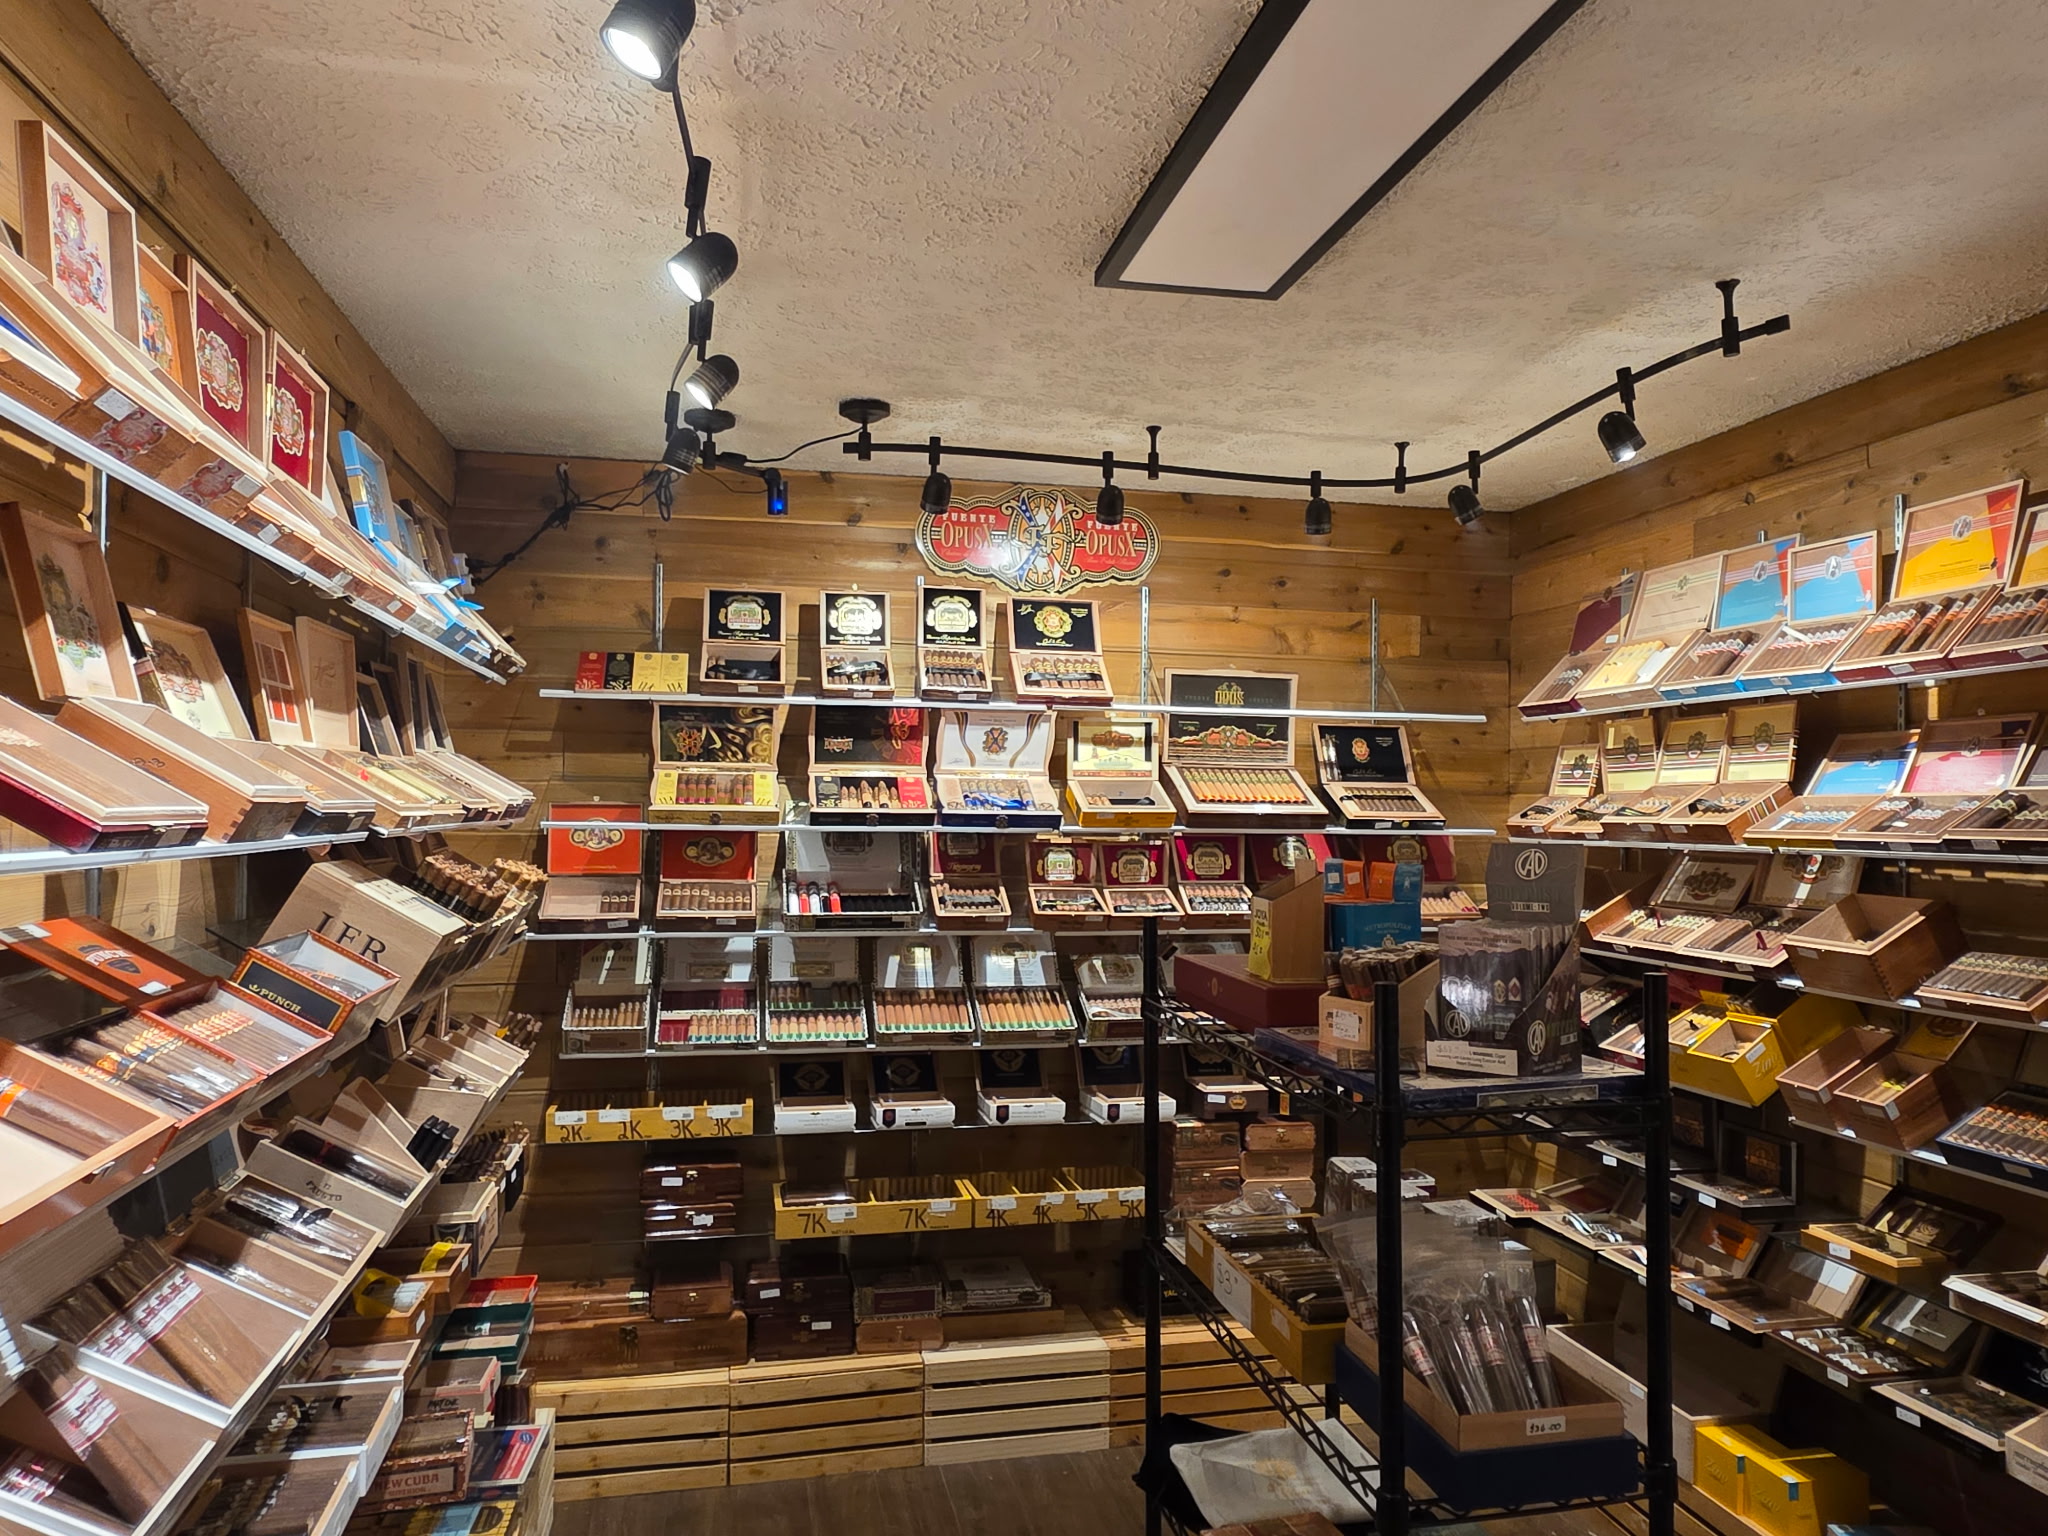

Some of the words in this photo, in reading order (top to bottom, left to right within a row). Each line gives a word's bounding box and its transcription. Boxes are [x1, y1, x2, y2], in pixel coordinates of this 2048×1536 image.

[942, 512, 996, 524] FUENTE
[259, 987, 302, 1014] PUNCH
[559, 1125, 584, 1143] 2K
[670, 1119, 694, 1138] 3K
[899, 1207, 928, 1229] 7K
[985, 1208, 1009, 1228] 4K
[1032, 1204, 1053, 1225] 4K
[1075, 1202, 1100, 1222] 5K
[1120, 1199, 1144, 1219] 5K
[797, 1212, 827, 1235] 7K
[404, 1473, 440, 1487] CUBA
